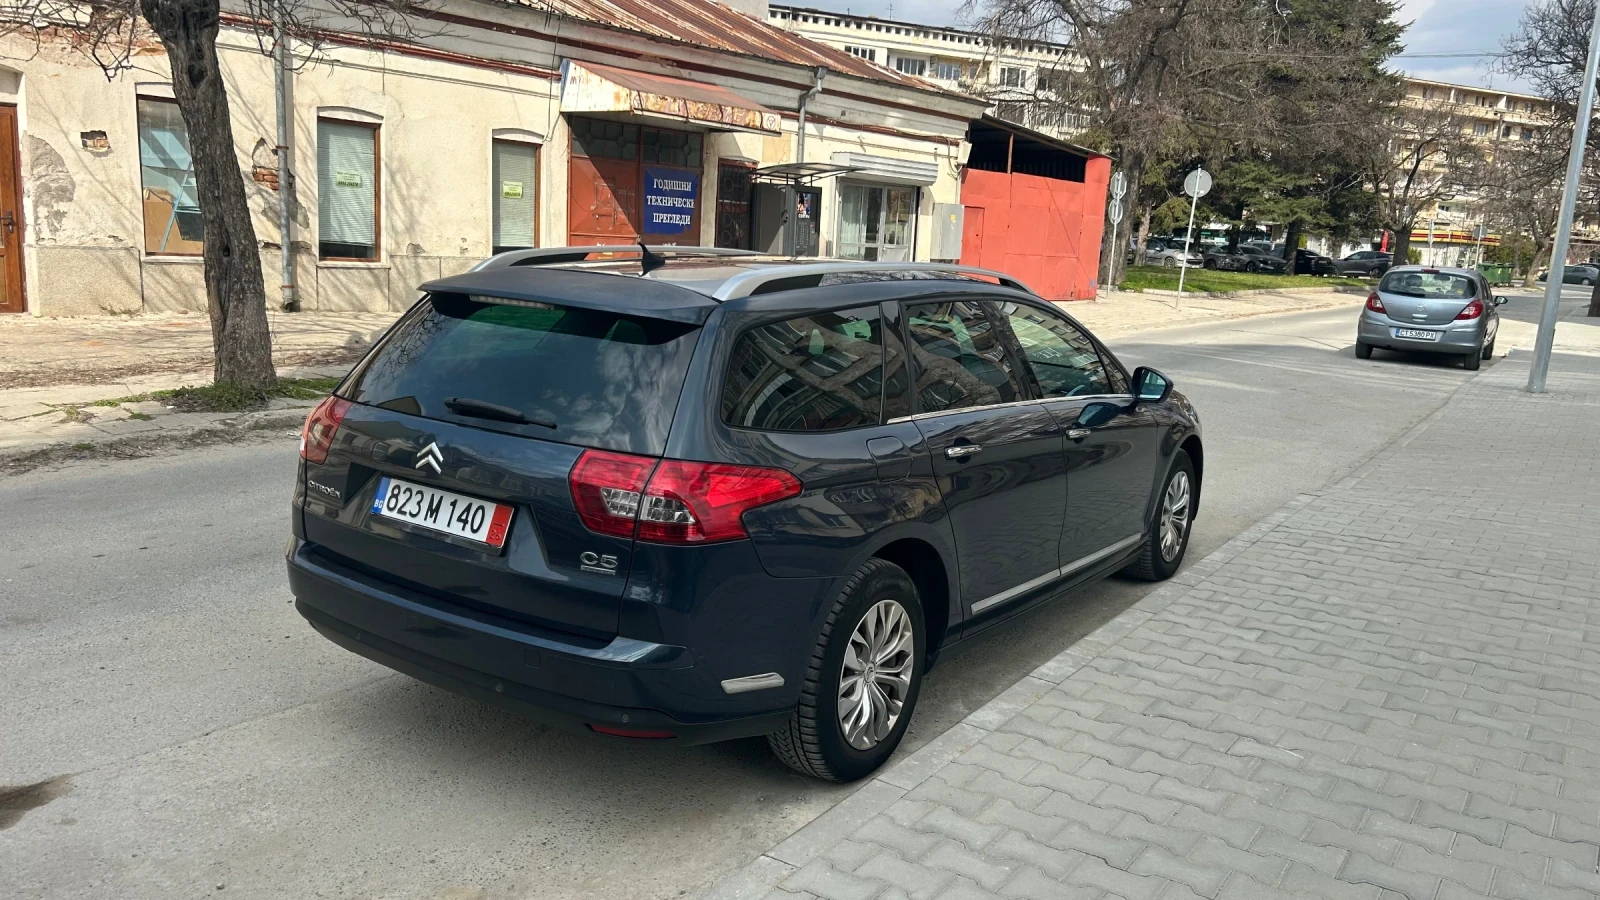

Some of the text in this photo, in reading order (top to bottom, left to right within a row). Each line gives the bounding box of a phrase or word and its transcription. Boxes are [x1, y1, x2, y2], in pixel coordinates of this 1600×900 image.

[653, 178, 692, 192] ГОДИШНИ
[652, 212, 691, 226] ПРЕГЛЕДИ
[373, 498, 384, 509] BG
[386, 484, 486, 534] 823 M 140
[580, 551, 618, 569] C5
